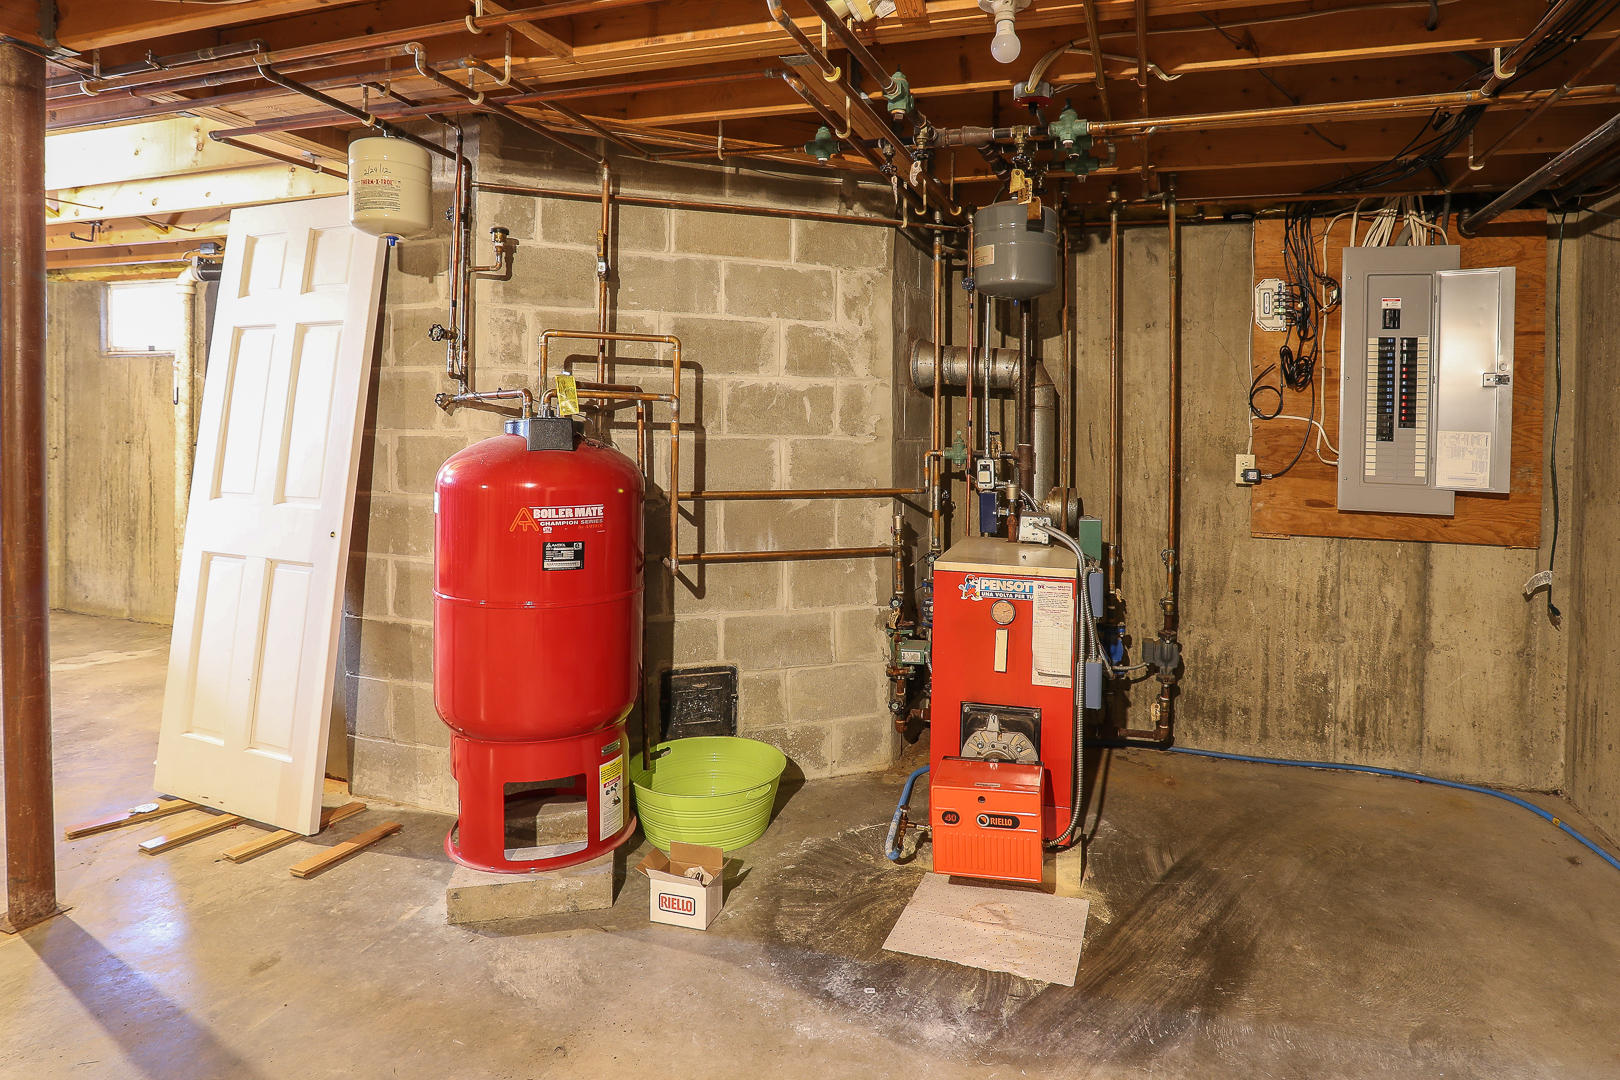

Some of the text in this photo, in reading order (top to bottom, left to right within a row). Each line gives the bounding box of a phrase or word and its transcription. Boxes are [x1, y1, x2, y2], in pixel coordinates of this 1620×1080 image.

[533, 506, 604, 519] BOILER MATE
[981, 579, 1034, 593] PENSOT
[944, 814, 1013, 826] 40 RIELLO
[660, 895, 693, 913] RIELLO
